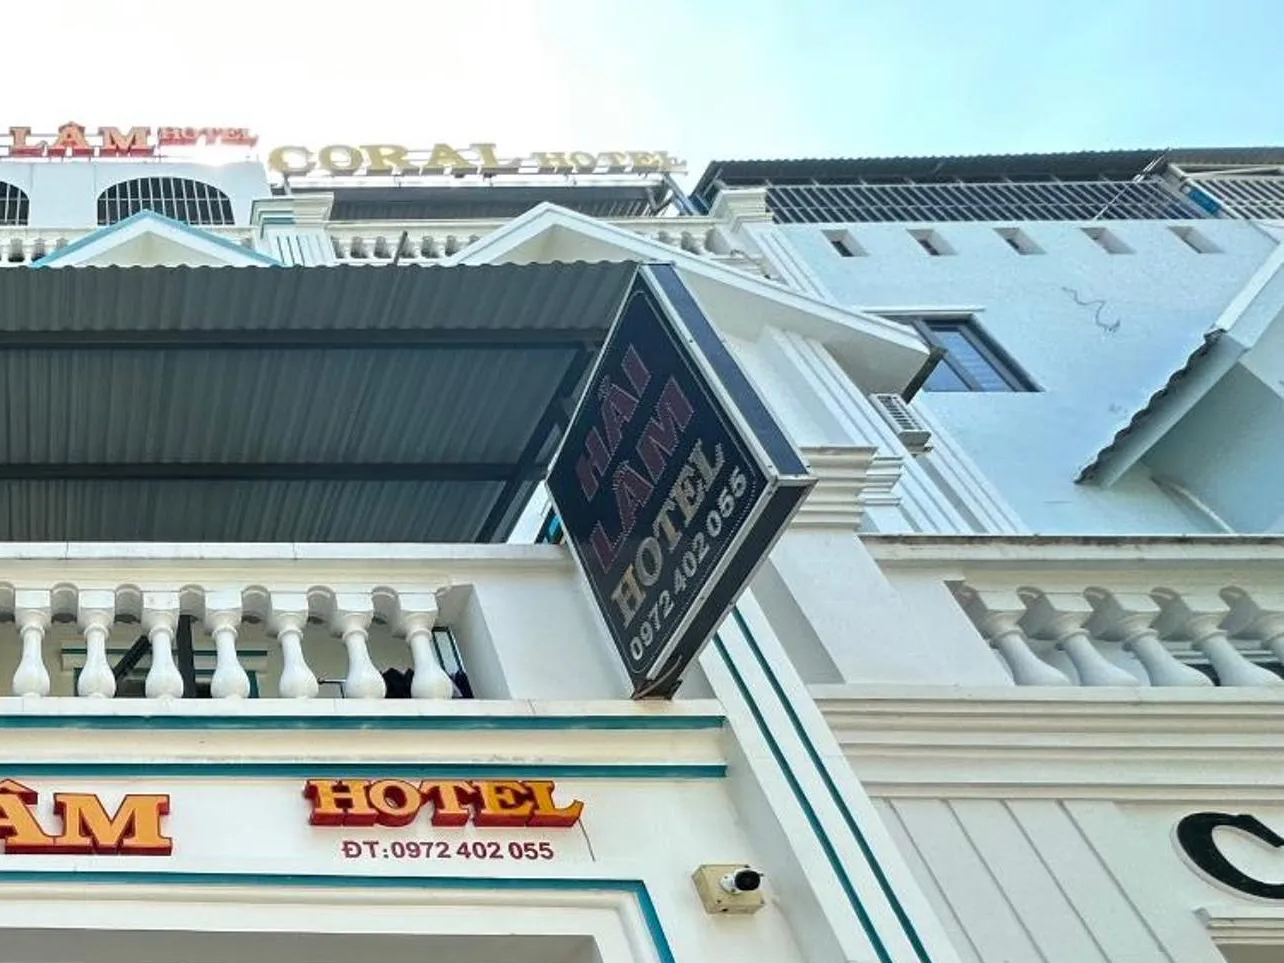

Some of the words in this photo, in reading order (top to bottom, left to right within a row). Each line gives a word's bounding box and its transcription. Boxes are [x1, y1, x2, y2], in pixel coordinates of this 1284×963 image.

[158, 126, 260, 147] HOTEL
[268, 143, 521, 176] CORAL
[530, 149, 689, 176] HOTEL
[611, 437, 726, 628] HOTEL
[629, 588, 676, 661] 0972
[672, 531, 711, 594] 402
[705, 465, 748, 539] 055
[303, 778, 585, 828] HOTEL
[456, 841, 505, 860] 402
[509, 842, 555, 861] 055
